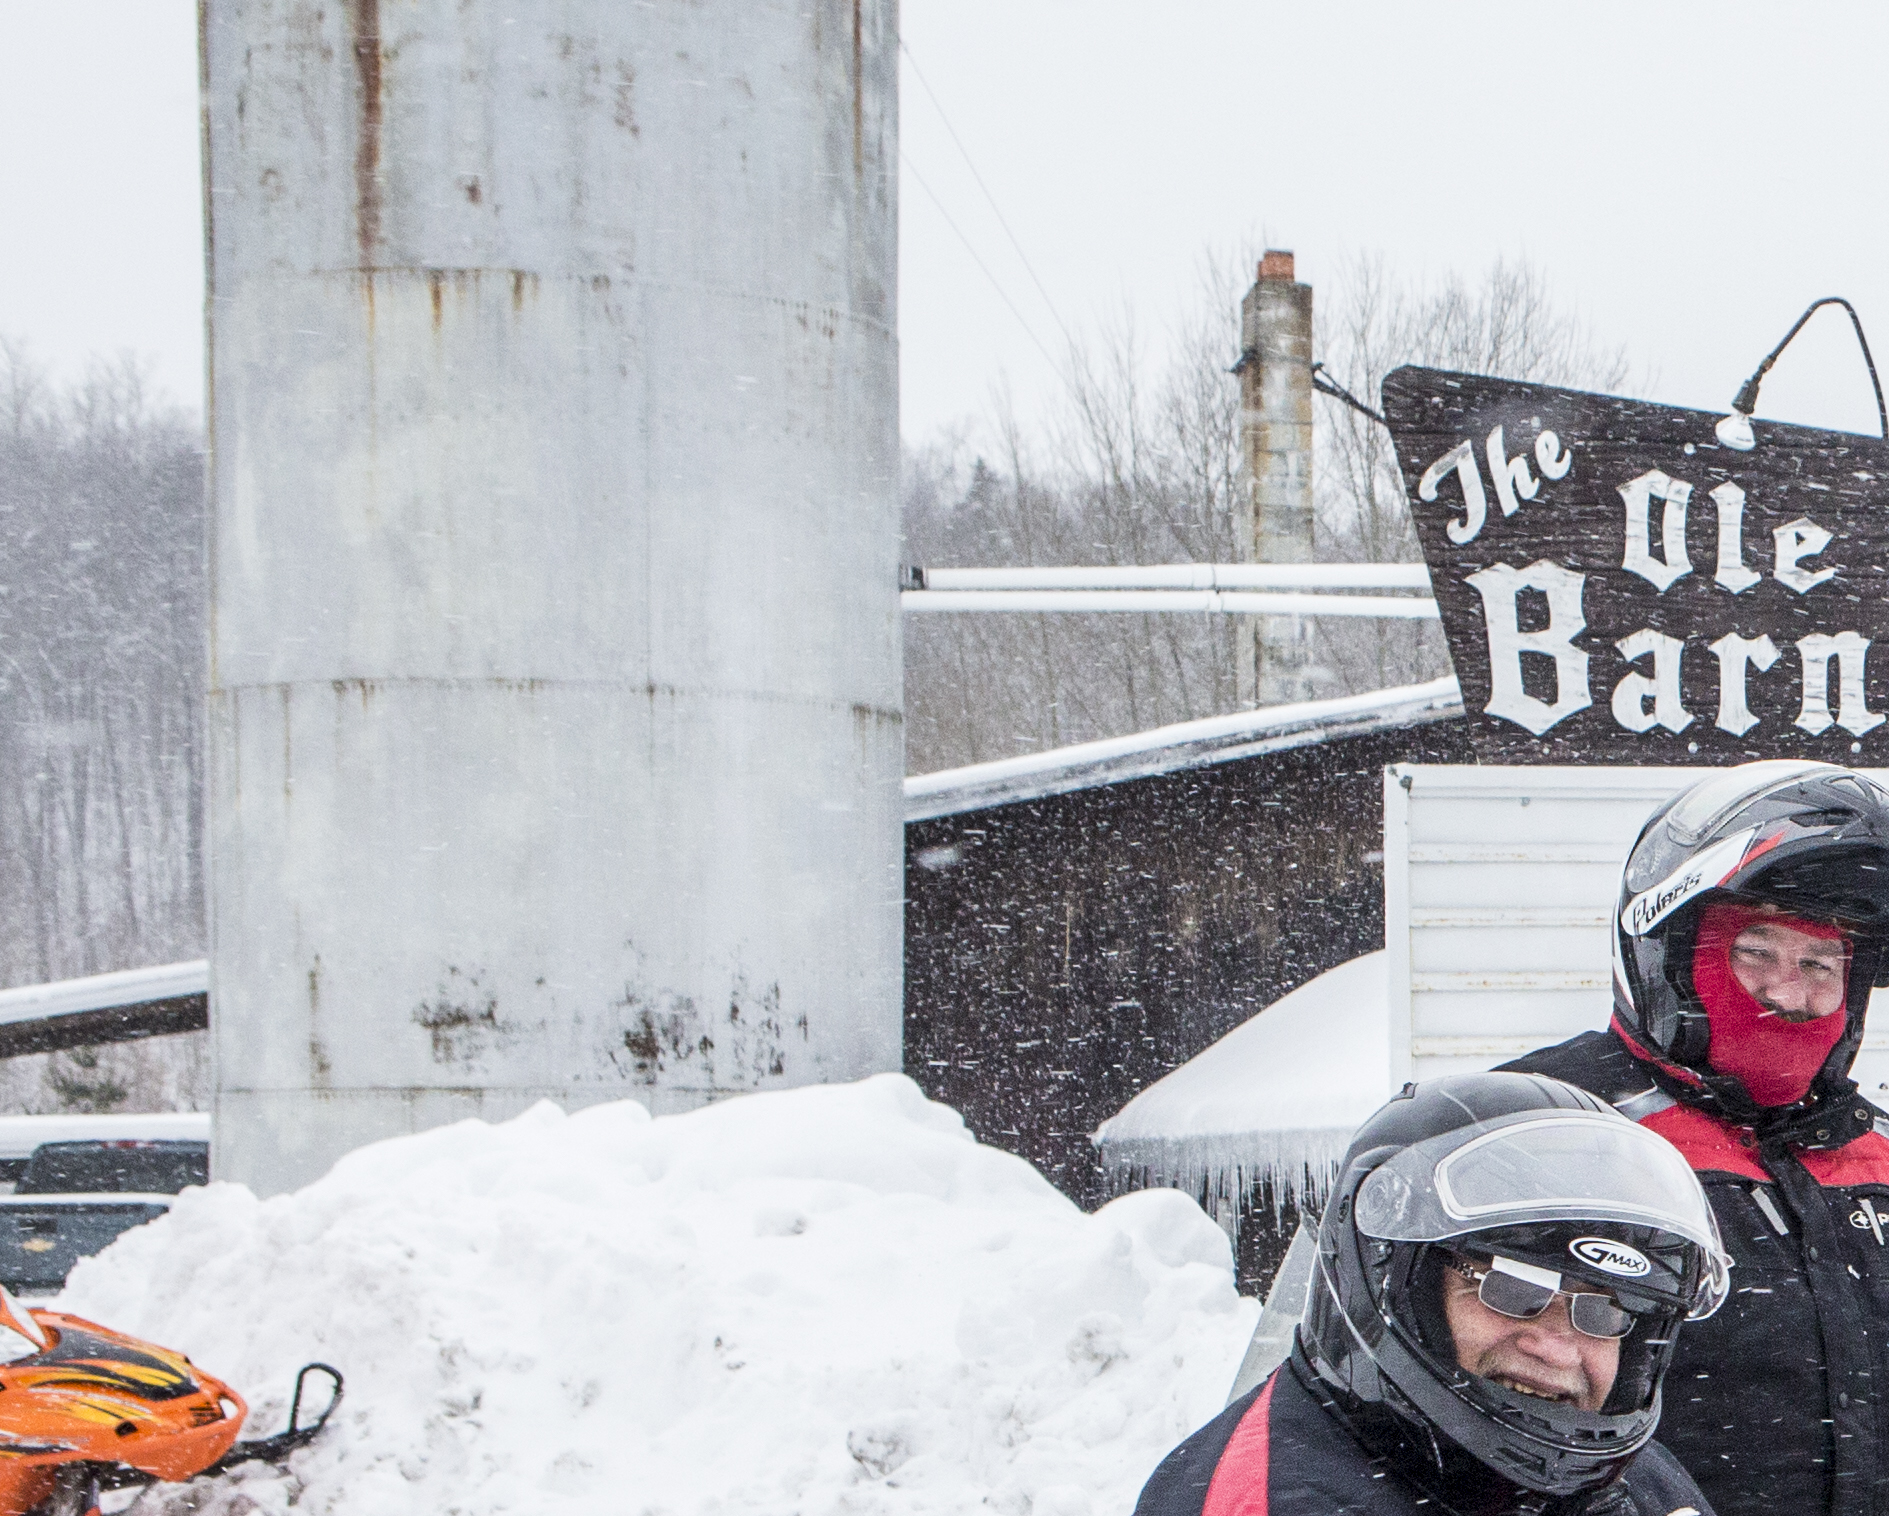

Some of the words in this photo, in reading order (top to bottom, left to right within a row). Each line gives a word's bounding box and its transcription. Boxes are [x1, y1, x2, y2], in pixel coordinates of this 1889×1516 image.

[1418, 426, 1572, 545] The
[1616, 469, 1837, 594] Ole
[1464, 558, 1887, 737] Barn
[1633, 872, 1702, 938] Polaris
